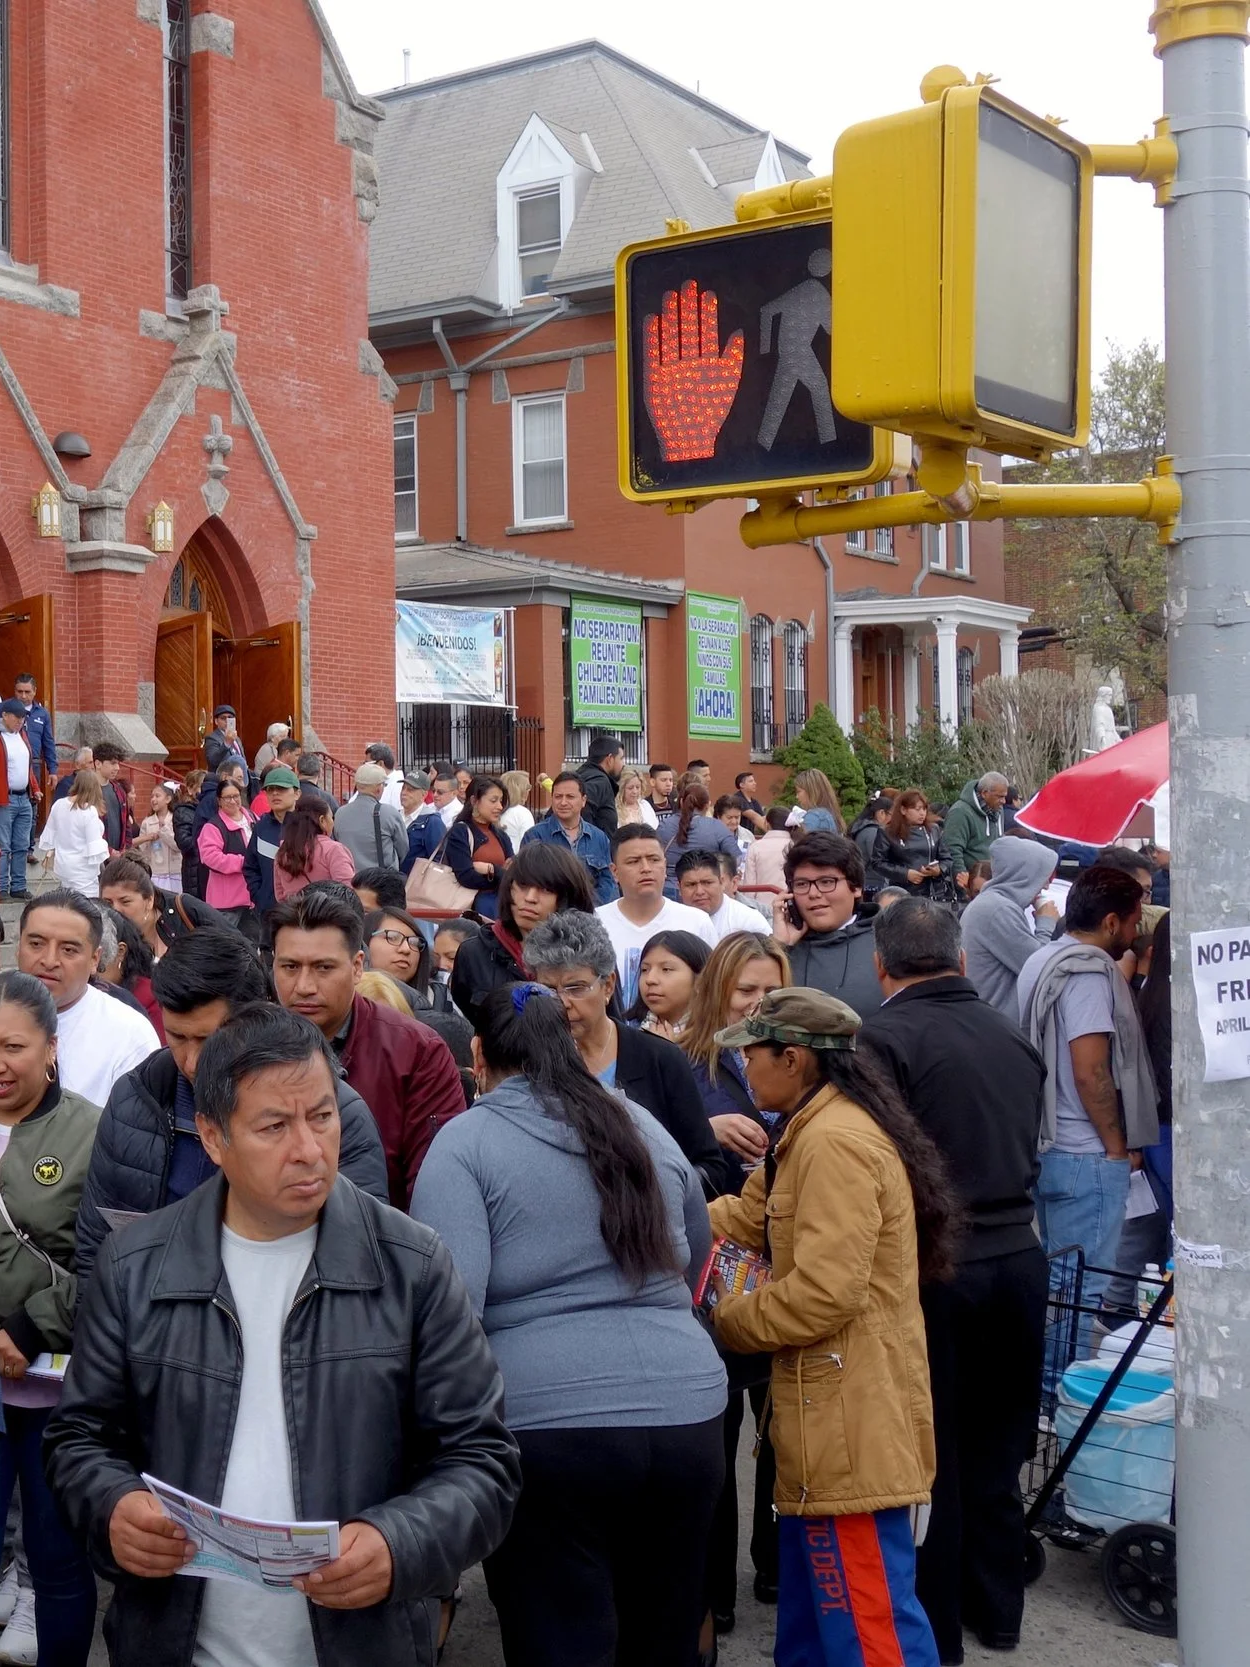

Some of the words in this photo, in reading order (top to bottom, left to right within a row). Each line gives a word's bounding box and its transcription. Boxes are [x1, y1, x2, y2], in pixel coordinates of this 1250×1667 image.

[574, 619, 586, 638] NO
[690, 617, 697, 630] NO
[701, 619, 707, 631] LA
[591, 642, 626, 663] REUNITE
[577, 662, 619, 683] CHILDREN
[622, 666, 637, 685] AND
[578, 684, 616, 705] FAMILIES
[695, 688, 735, 719] ¡AHORA!
[1197, 942, 1224, 966] NO
[1229, 939, 1250, 962] PA
[1216, 1017, 1250, 1036] APRIL
[810, 1552, 850, 1616] DEPT.
